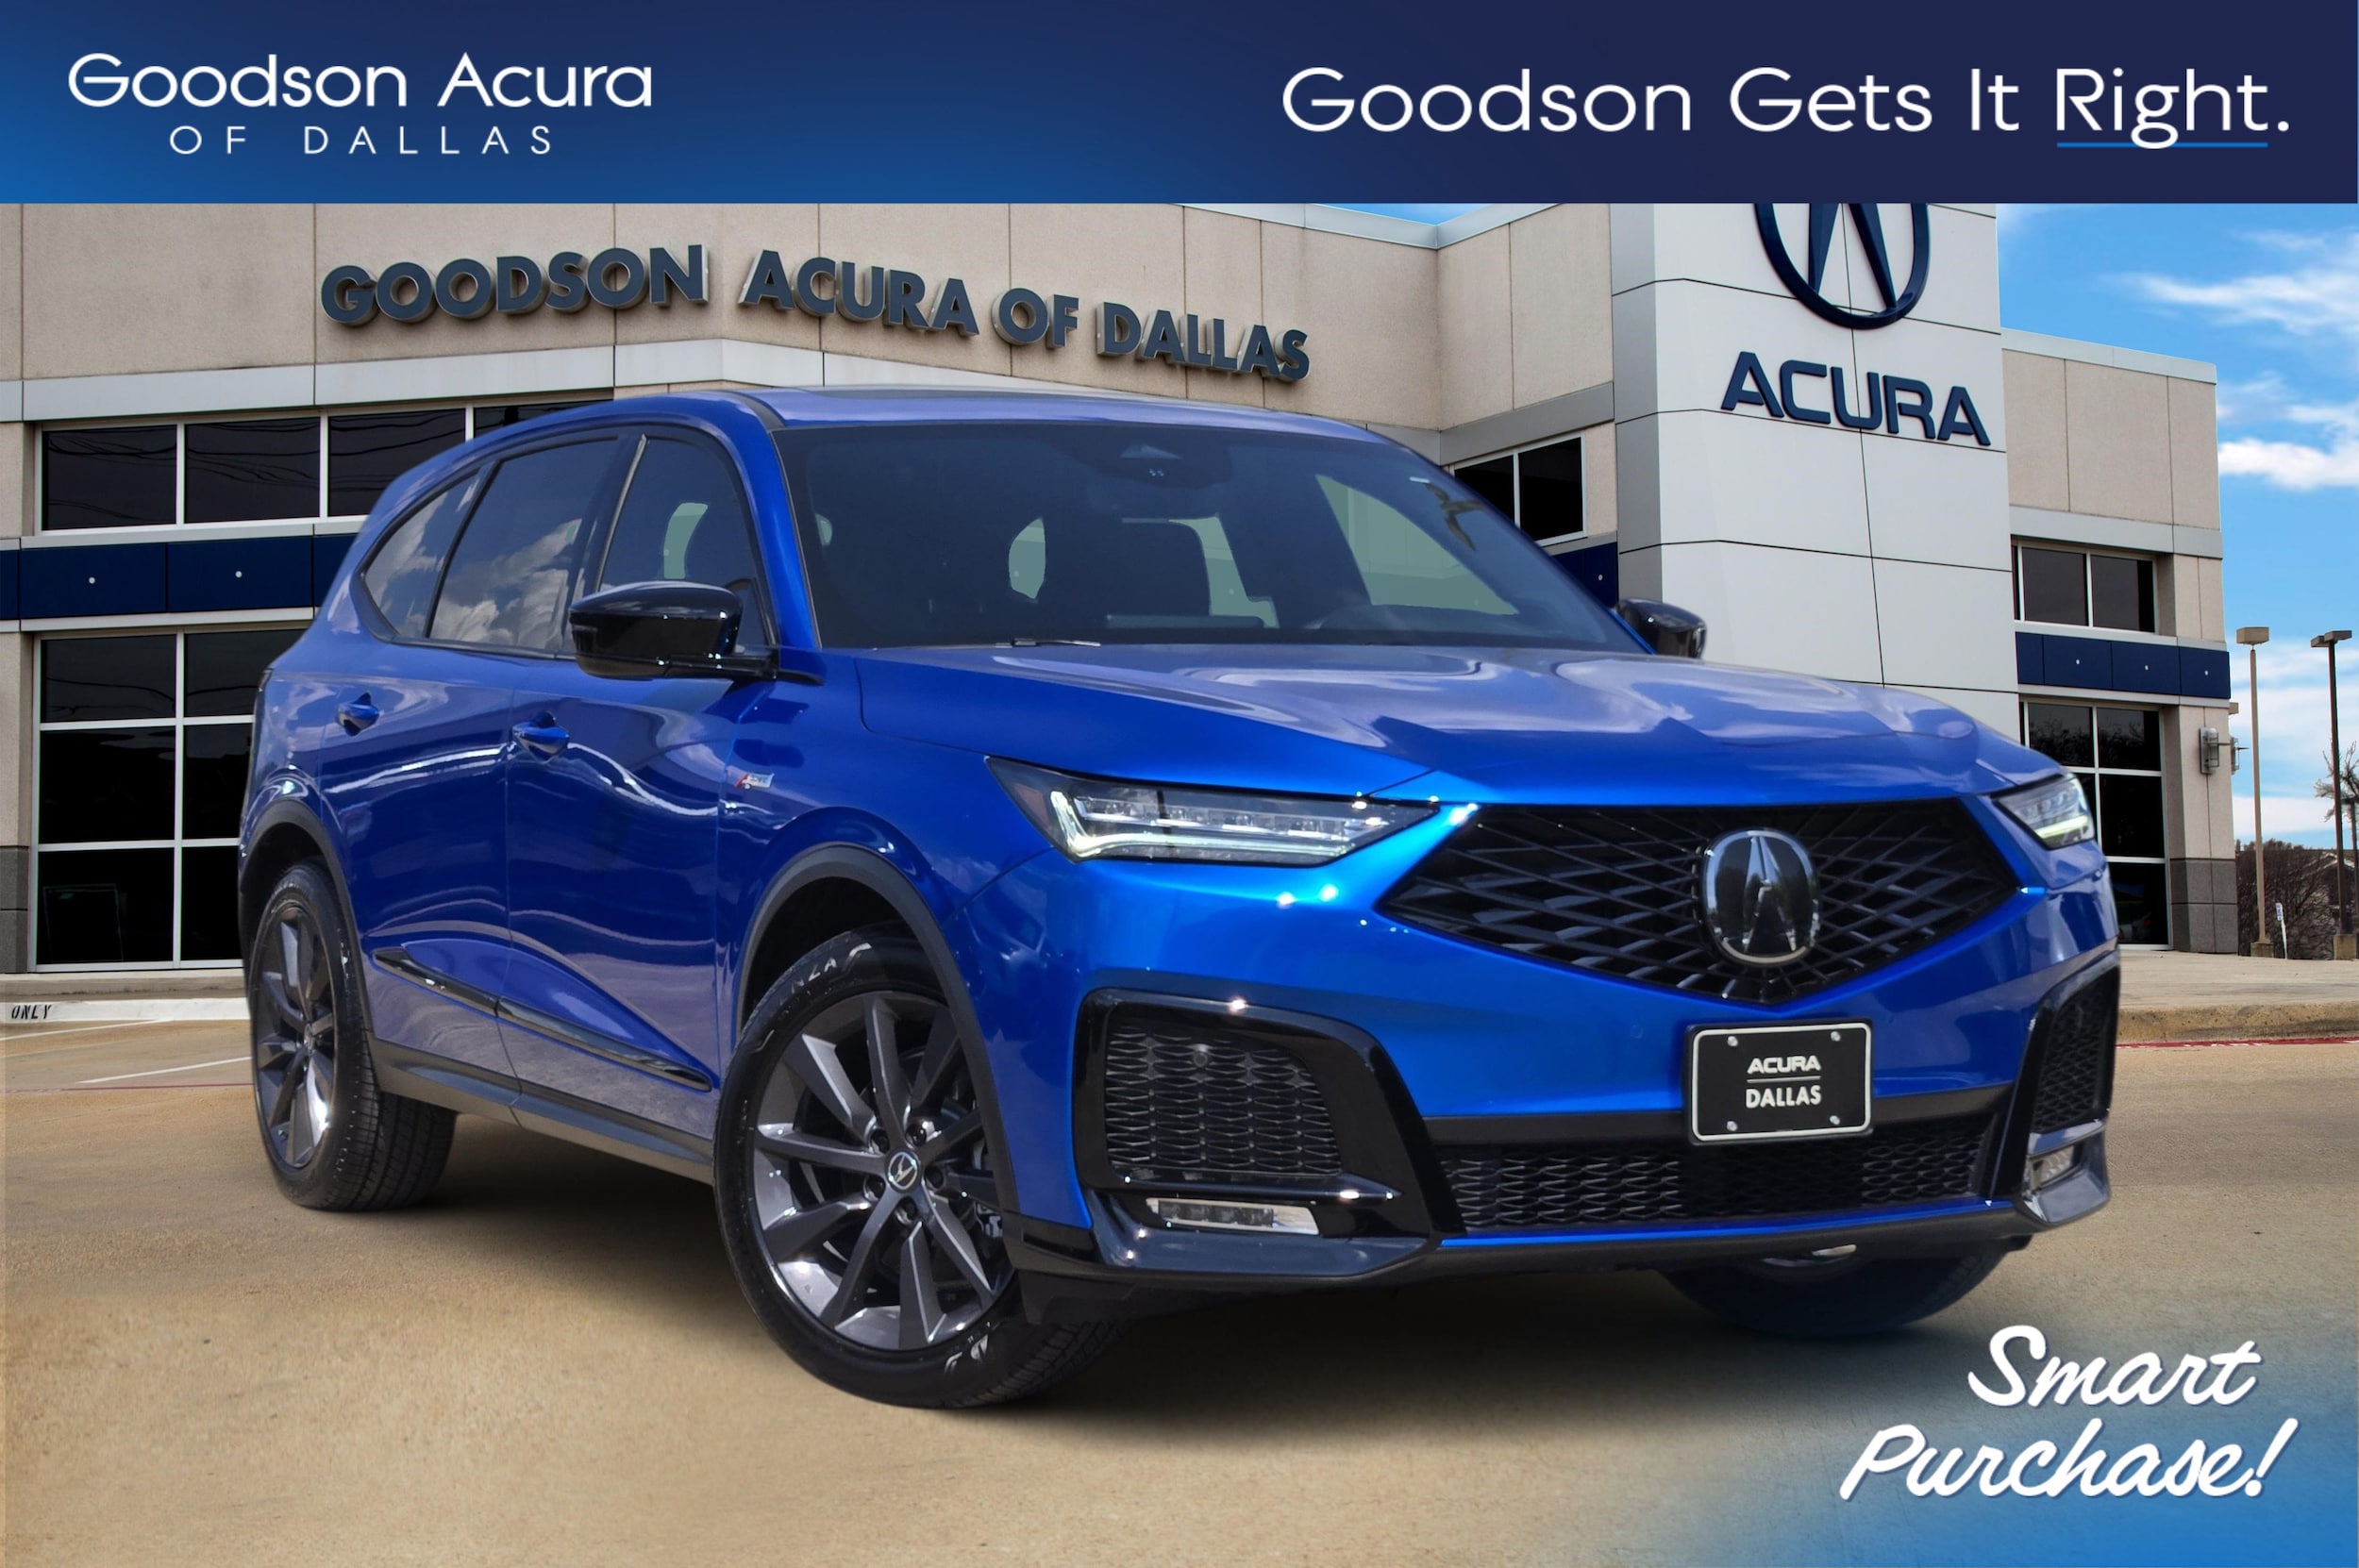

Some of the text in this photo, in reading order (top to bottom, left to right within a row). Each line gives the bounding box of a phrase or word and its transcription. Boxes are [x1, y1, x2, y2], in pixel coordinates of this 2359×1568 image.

[321, 244, 1310, 382] GOODSON ACURA OF DALLAS
[1720, 351, 1991, 447] ACURA
[10, 1004, 52, 1020] ONLY
[1747, 1055, 1822, 1075] ACURA
[1746, 1085, 1822, 1109] DALLAS
